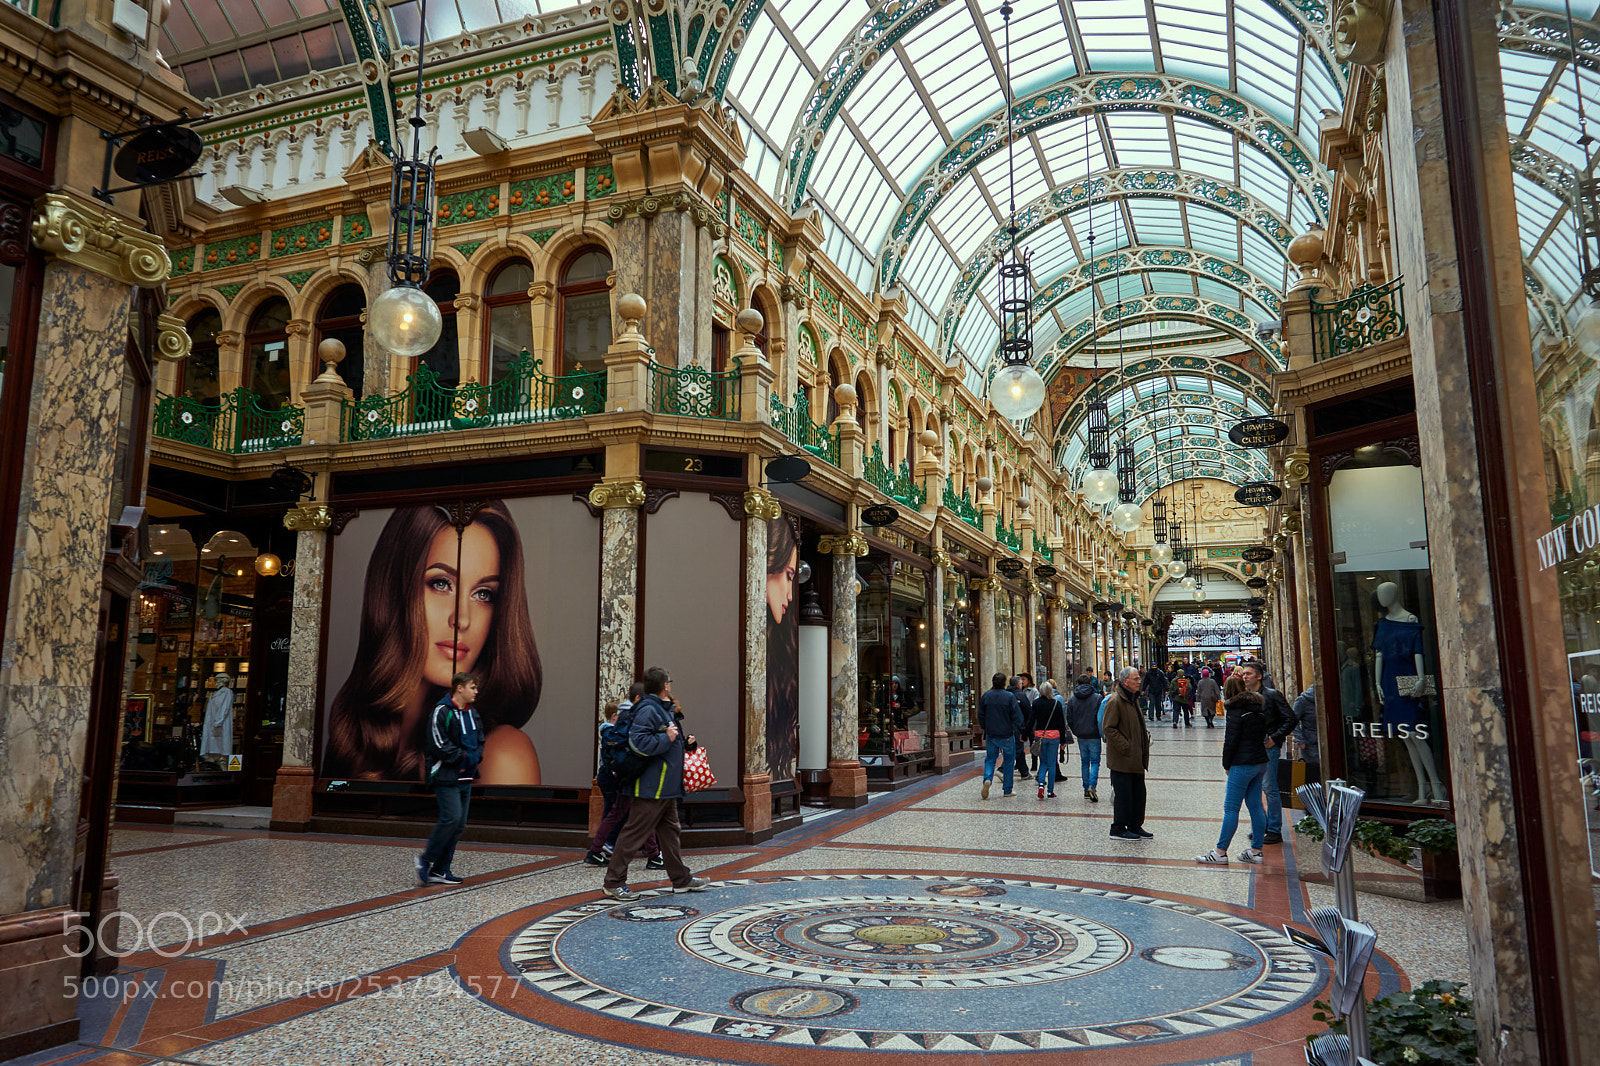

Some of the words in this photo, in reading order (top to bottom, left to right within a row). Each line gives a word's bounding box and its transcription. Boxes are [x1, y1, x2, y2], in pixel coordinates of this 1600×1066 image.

[1242, 422, 1275, 433] HAWES
[1241, 434, 1276, 444] CURTIS
[684, 458, 704, 472] 23
[1536, 523, 1567, 571] NEW
[1351, 722, 1430, 740] REISS
